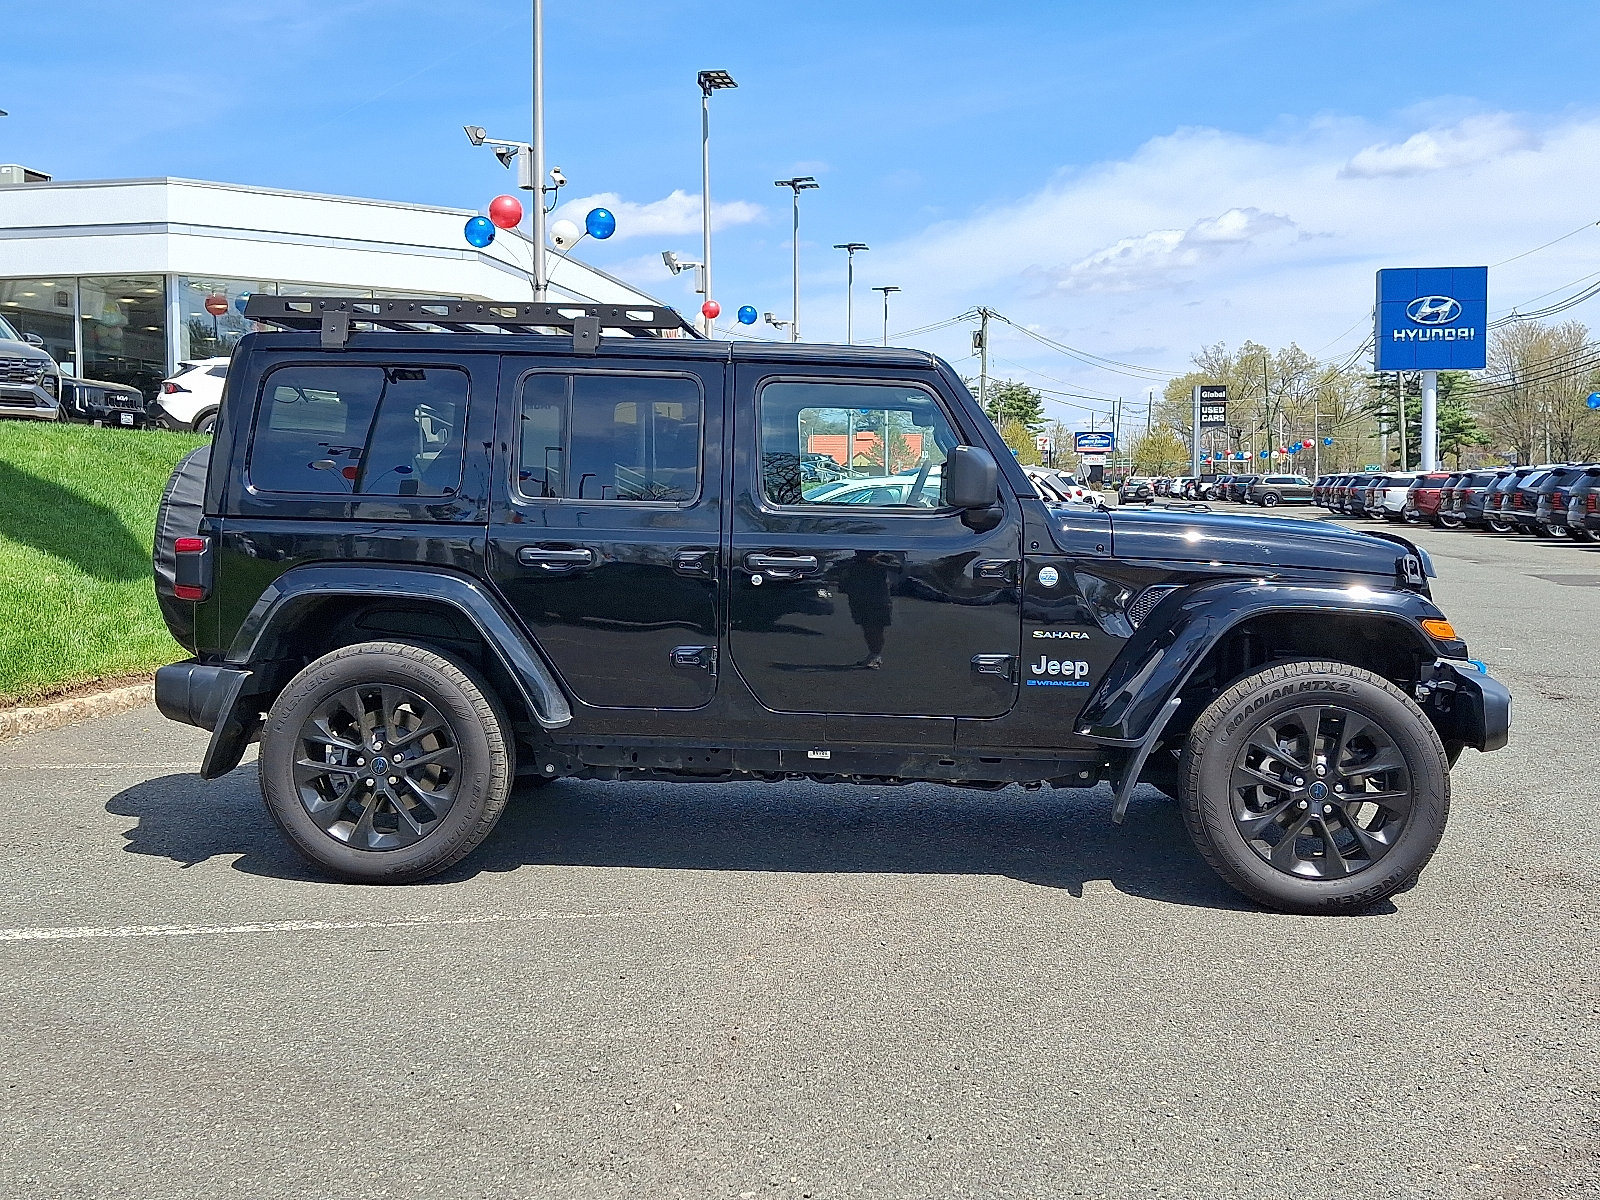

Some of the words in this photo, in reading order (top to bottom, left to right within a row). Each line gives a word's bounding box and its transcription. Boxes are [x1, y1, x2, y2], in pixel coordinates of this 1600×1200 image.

[1393, 328, 1475, 341] HYUNDAI
[1032, 630, 1090, 640] SAHARA
[400, 663, 443, 687] All-Weather
[1030, 655, 1089, 680] Jeep
[1225, 683, 1294, 737] ROADIAN
[1298, 680, 1351, 693] HTX2
